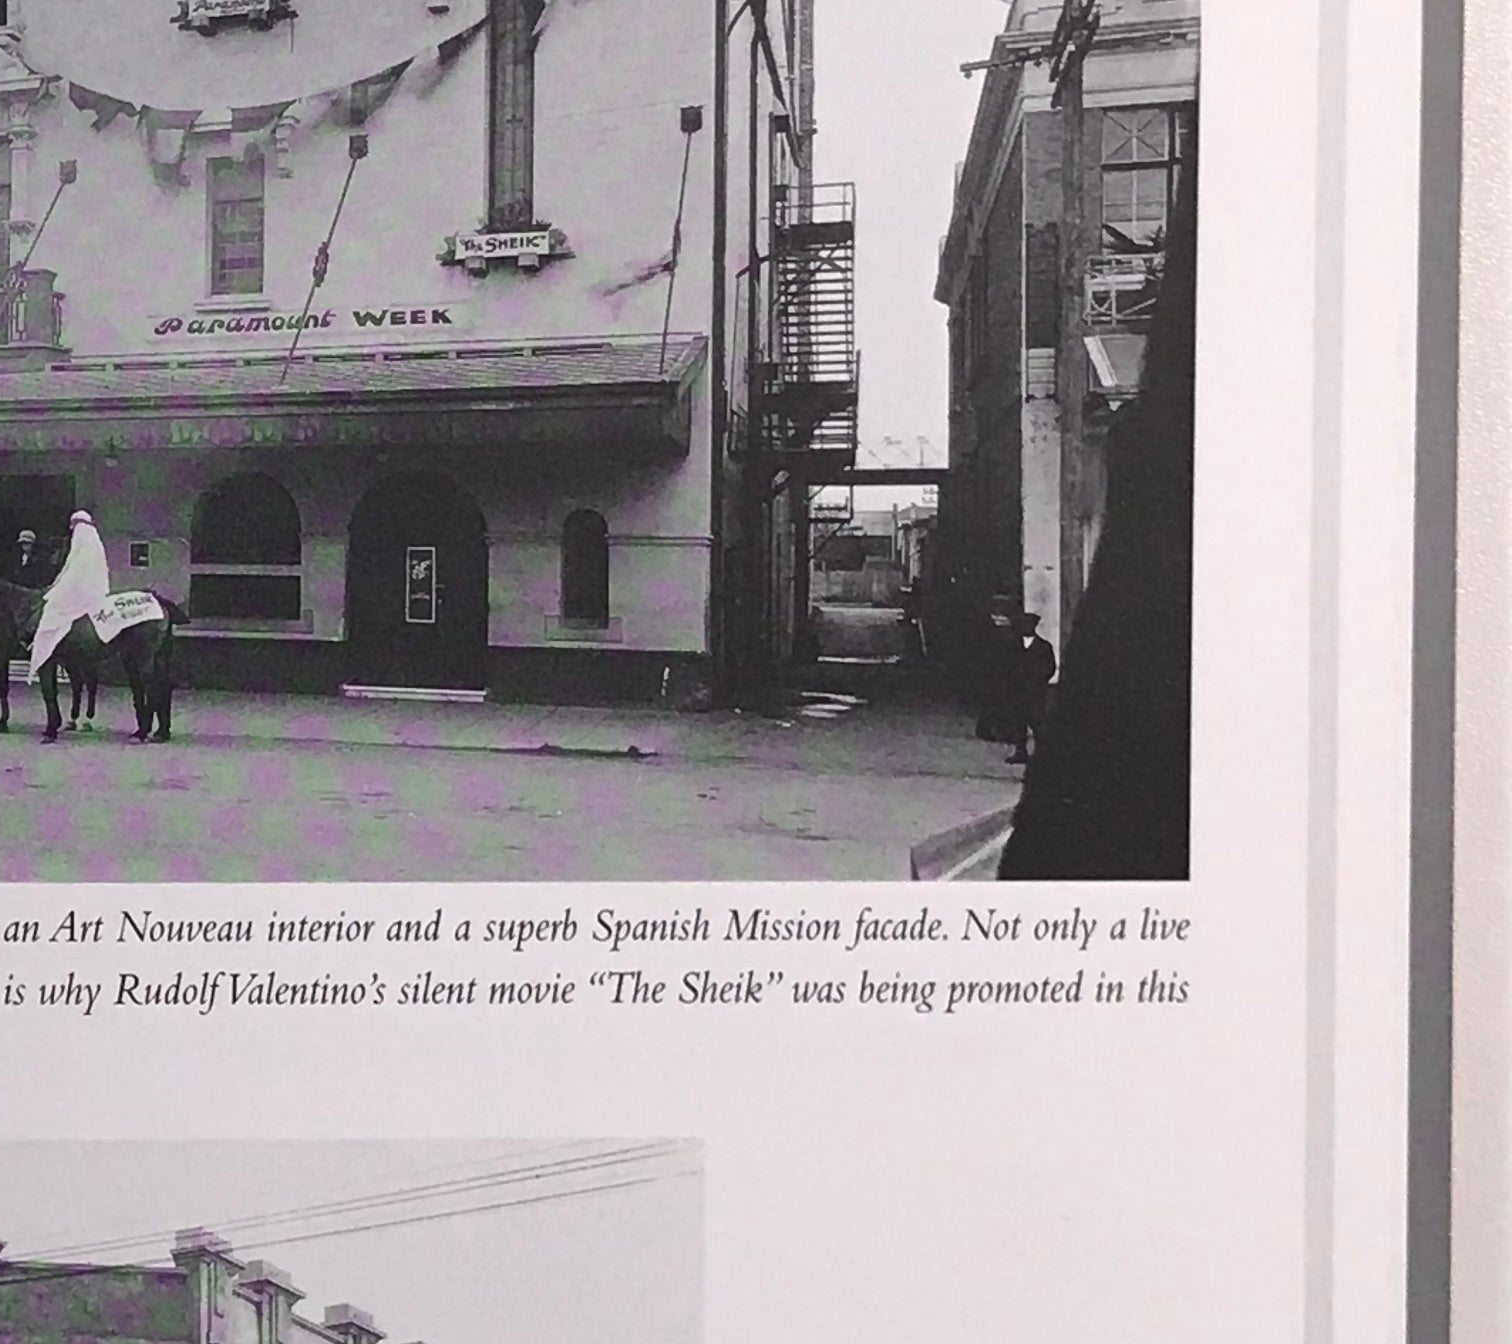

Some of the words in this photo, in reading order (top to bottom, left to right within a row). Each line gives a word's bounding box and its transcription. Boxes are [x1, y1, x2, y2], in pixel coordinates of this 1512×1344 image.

[154, 309, 336, 336] Paramount
[352, 308, 453, 327] WEEK
[3, 920, 41, 943] an
[48, 910, 104, 943] Art
[116, 909, 255, 944] Nouveau
[268, 910, 376, 944] interior
[386, 908, 442, 942] and
[454, 920, 472, 943] a
[483, 907, 578, 952] superb
[592, 908, 710, 952] Spanish
[723, 908, 841, 942] Mission
[845, 906, 949, 952] facade.
[961, 908, 1022, 942] Not
[1034, 907, 1097, 951] only
[1110, 918, 1128, 942] a
[1140, 906, 1191, 941] live
[4, 973, 27, 1006] is
[39, 971, 103, 1016] why
[113, 970, 226, 1016] Rudolf
[397, 970, 478, 1006] silent
[489, 973, 576, 1005] movie
[792, 981, 847, 1004] was
[858, 969, 937, 1014] being
[943, 969, 1084, 1014] promoted
[1095, 971, 1125, 1004] in
[1137, 969, 1190, 1004] this
